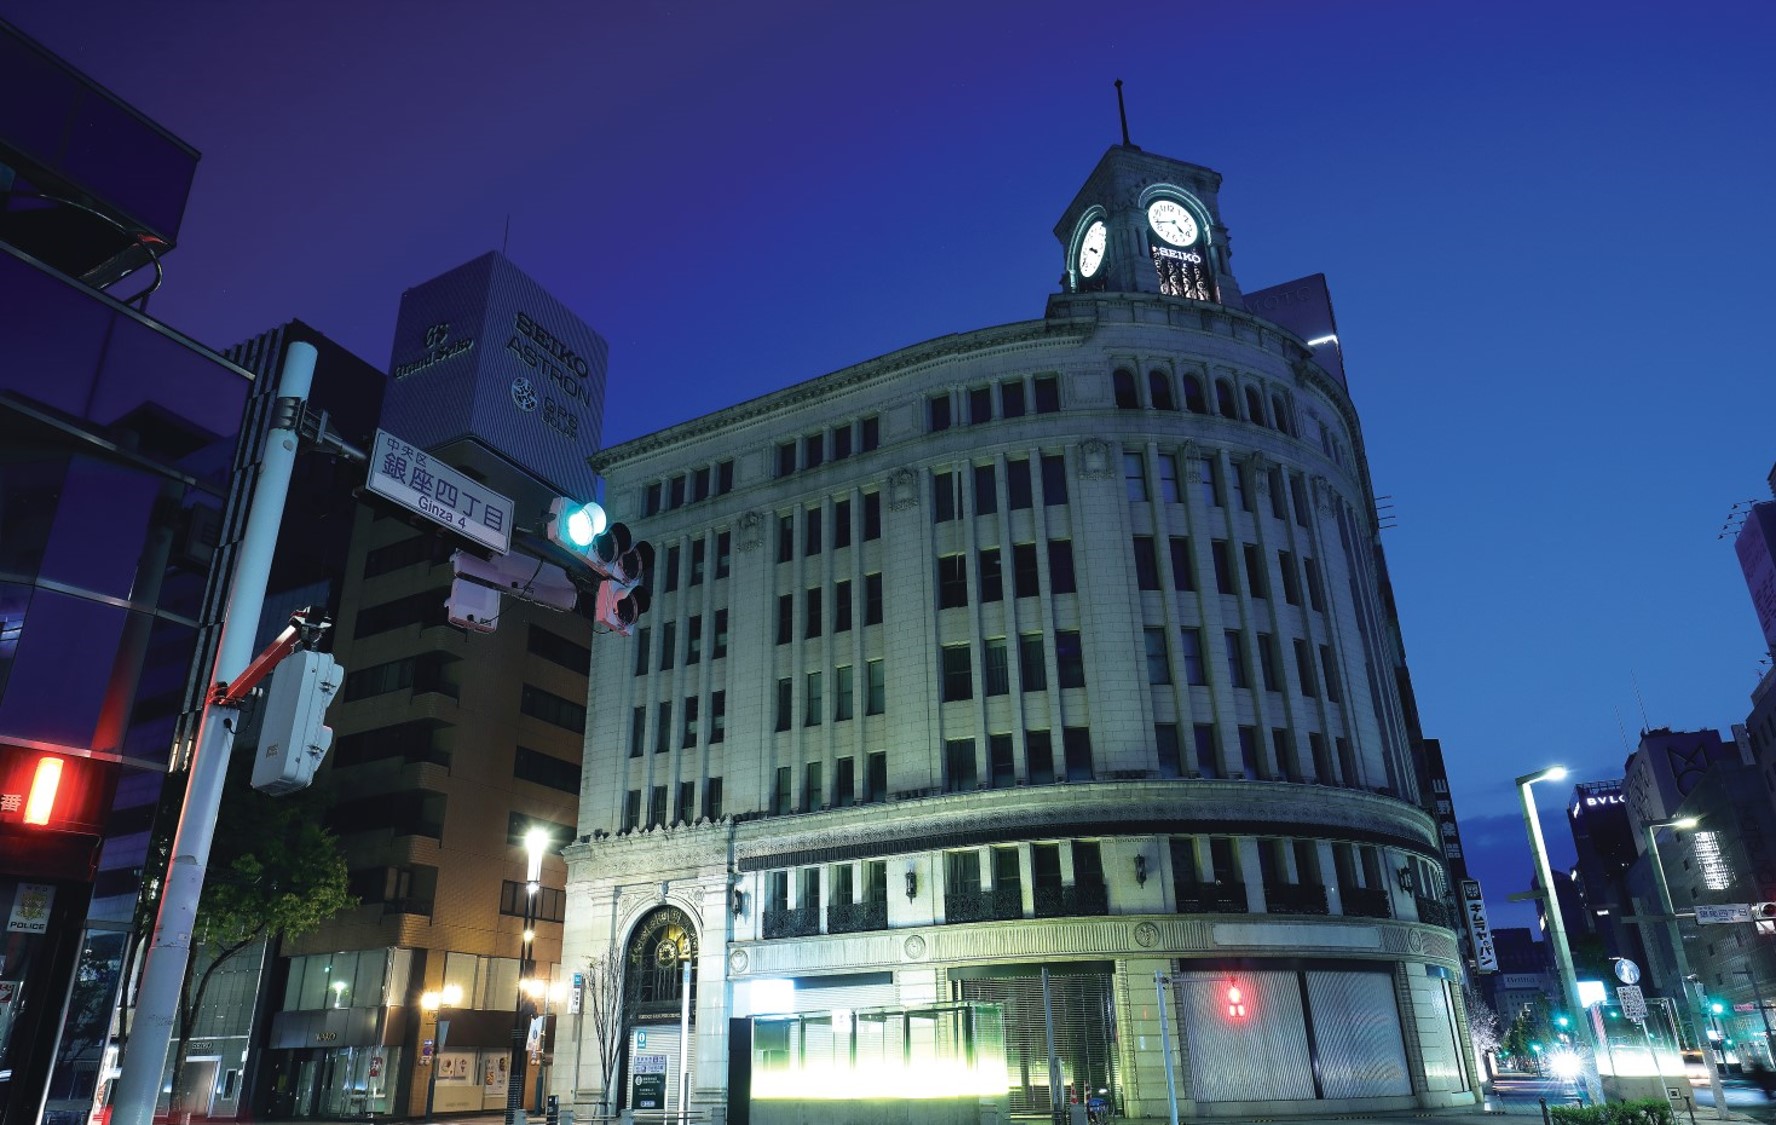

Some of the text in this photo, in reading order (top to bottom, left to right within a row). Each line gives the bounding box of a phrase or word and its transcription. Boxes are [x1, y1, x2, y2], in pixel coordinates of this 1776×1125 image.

[1159, 247, 1202, 265] SEIKO
[514, 312, 589, 380] SEIKO
[506, 337, 591, 408] ASTRON
[542, 397, 578, 430] GPS
[387, 438, 429, 468] 中央区
[382, 452, 503, 531] 銀座四丁目
[419, 496, 466, 529] Ginza 4
[10, 920, 46, 931] POLICE
[1470, 903, 1493, 966] キムラヤのパン
